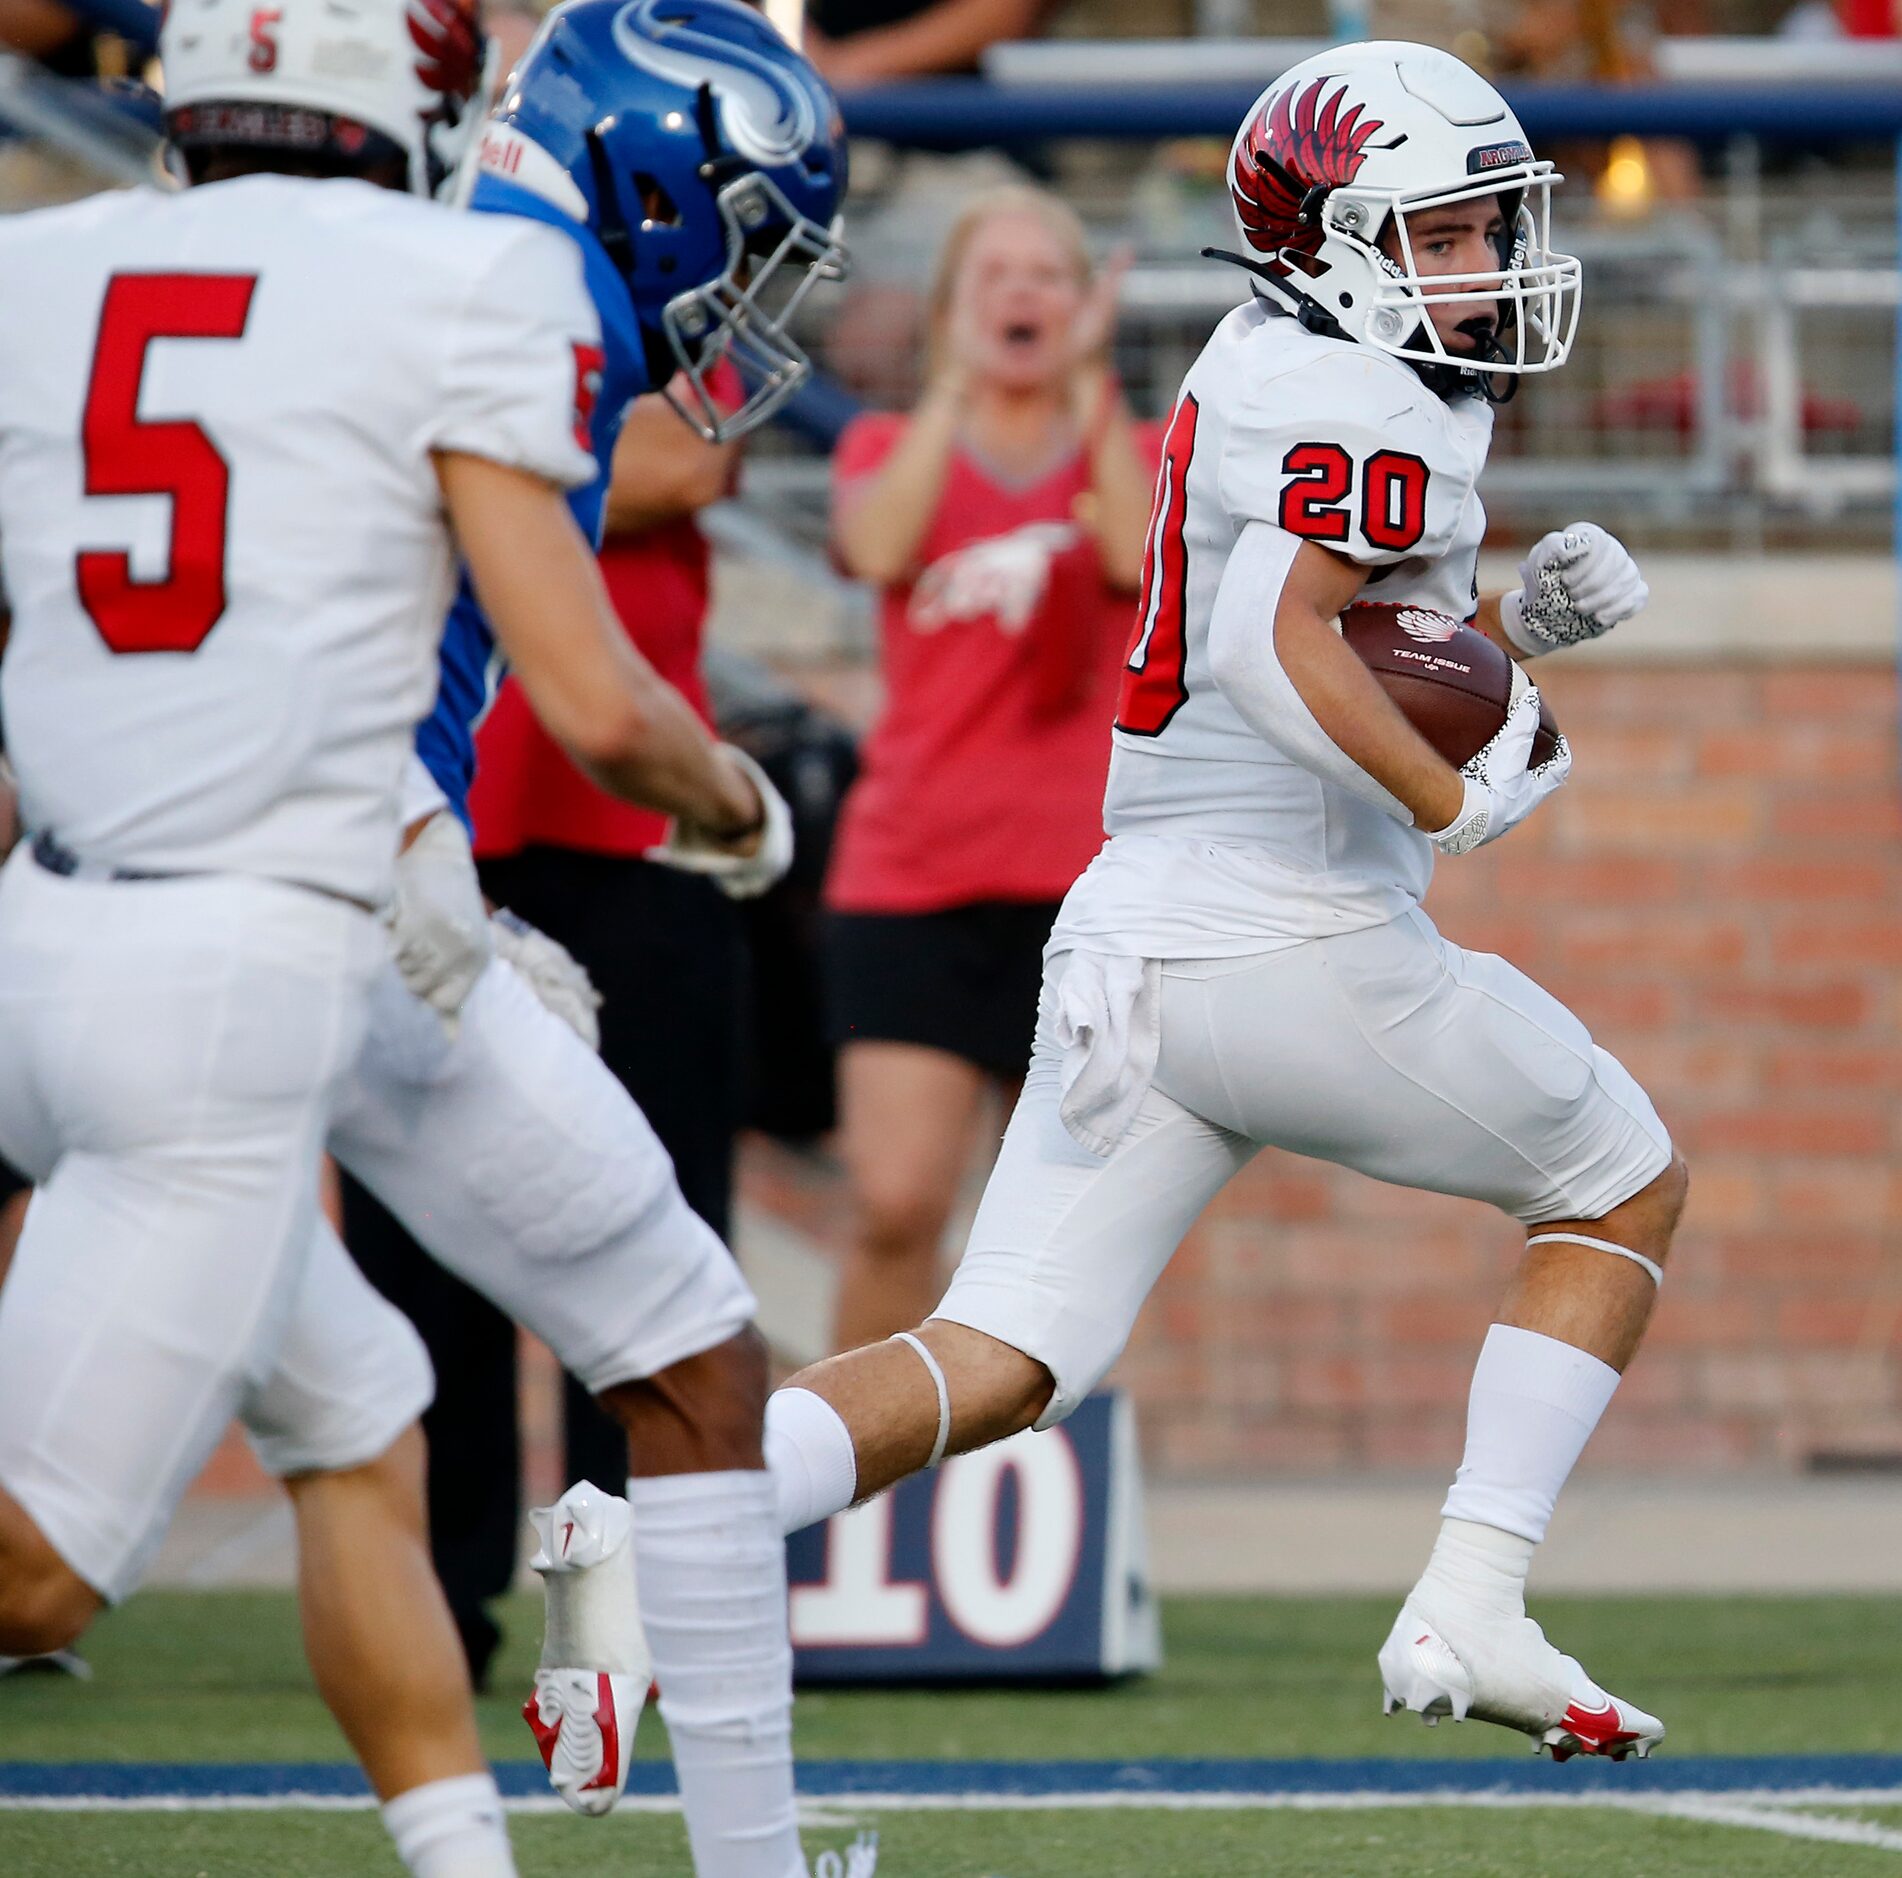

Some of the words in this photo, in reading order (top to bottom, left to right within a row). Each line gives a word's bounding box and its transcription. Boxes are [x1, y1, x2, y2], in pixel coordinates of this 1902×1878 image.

[248, 8, 283, 75] 5
[76, 272, 258, 655] 5
[1278, 442, 1431, 553] 20
[1392, 648, 1432, 662] TEAM
[1433, 657, 1472, 673] ISSUE
[789, 1425, 1085, 1648] 10
